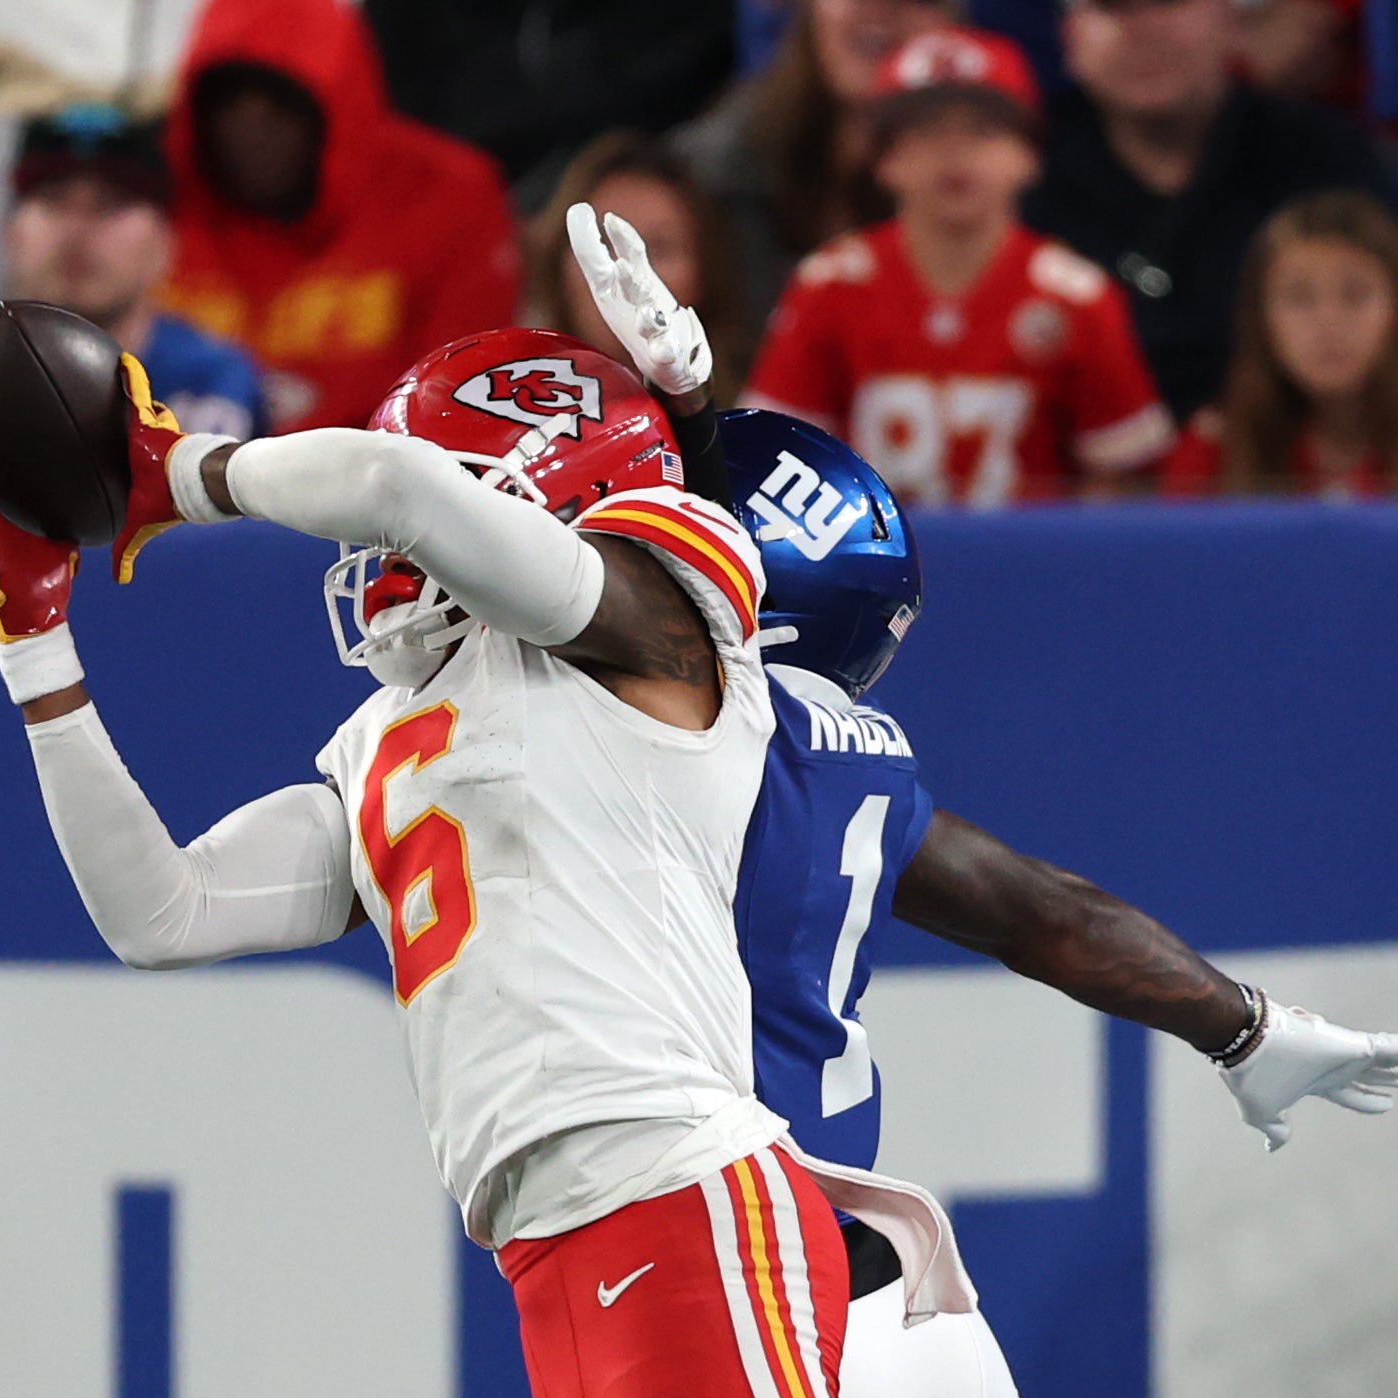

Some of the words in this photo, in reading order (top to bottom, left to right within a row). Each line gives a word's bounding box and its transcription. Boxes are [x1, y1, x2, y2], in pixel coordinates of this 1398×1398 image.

[486, 368, 583, 416] KC
[358, 699, 477, 1009] 6
[821, 795, 891, 1119] 1
